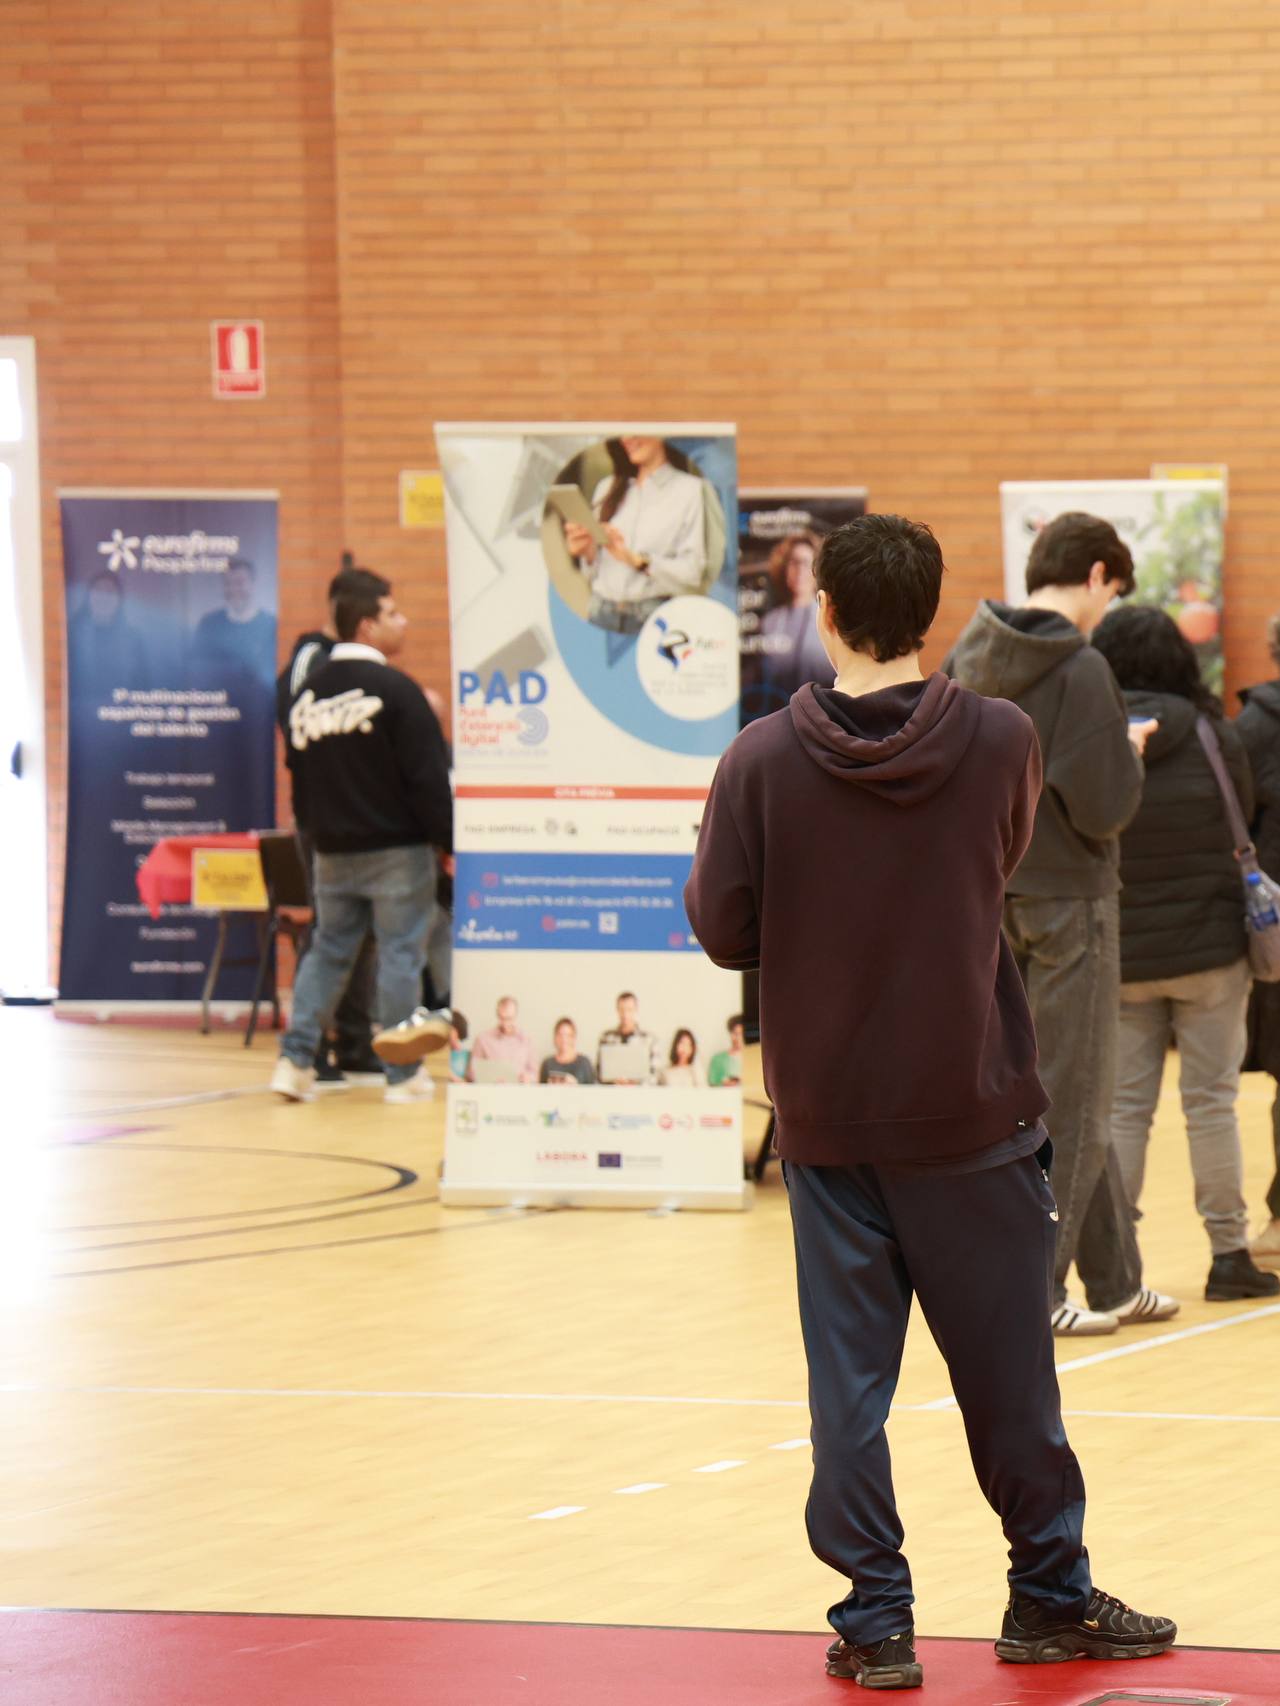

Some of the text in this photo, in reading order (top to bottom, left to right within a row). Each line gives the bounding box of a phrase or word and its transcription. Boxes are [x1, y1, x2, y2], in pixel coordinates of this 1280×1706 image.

[142, 531, 239, 556] eurofirms
[130, 690, 227, 704] multinacional
[458, 670, 548, 705] PAD
[166, 706, 186, 720] de
